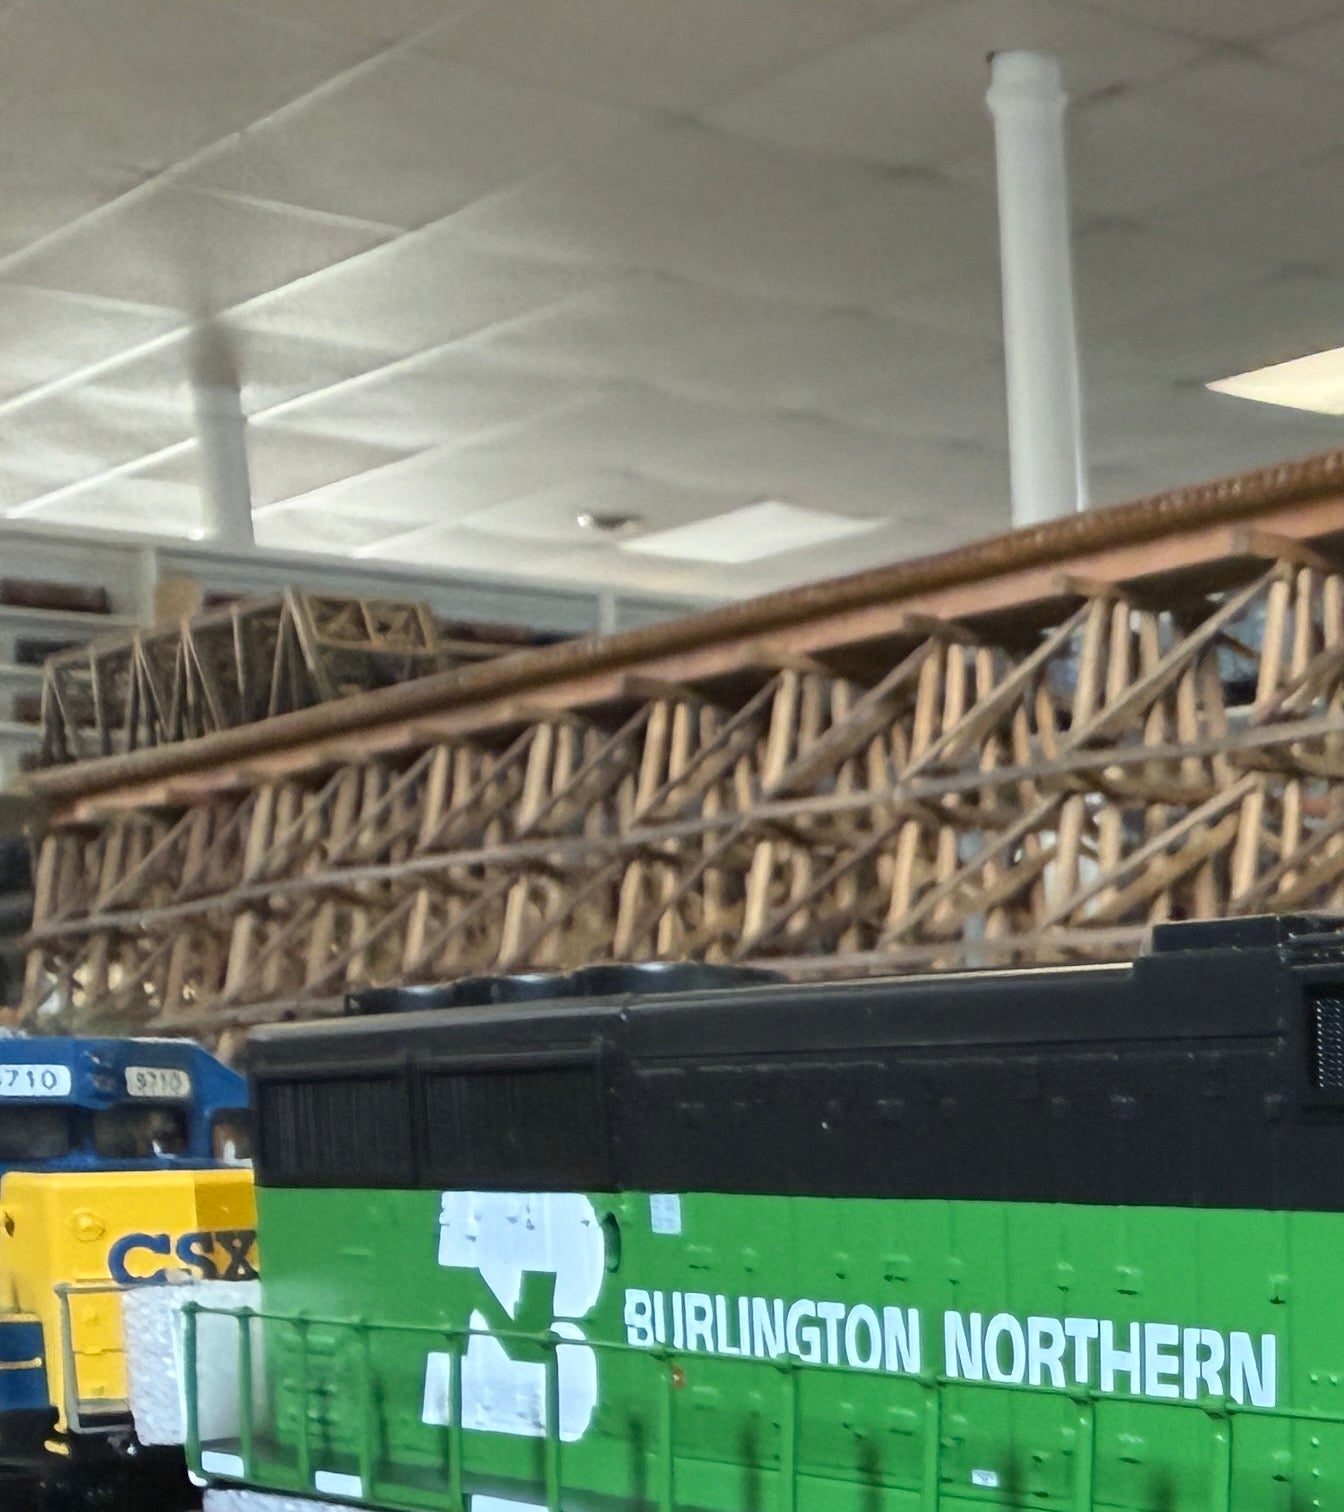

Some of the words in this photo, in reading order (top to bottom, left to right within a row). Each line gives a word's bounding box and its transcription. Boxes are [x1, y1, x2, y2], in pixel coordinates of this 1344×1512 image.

[0, 1069, 58, 1090] 710
[108, 1230, 260, 1284] CSX
[624, 1288, 921, 1375] BURLINGTON
[944, 1310, 1276, 1408] NORTHERN
